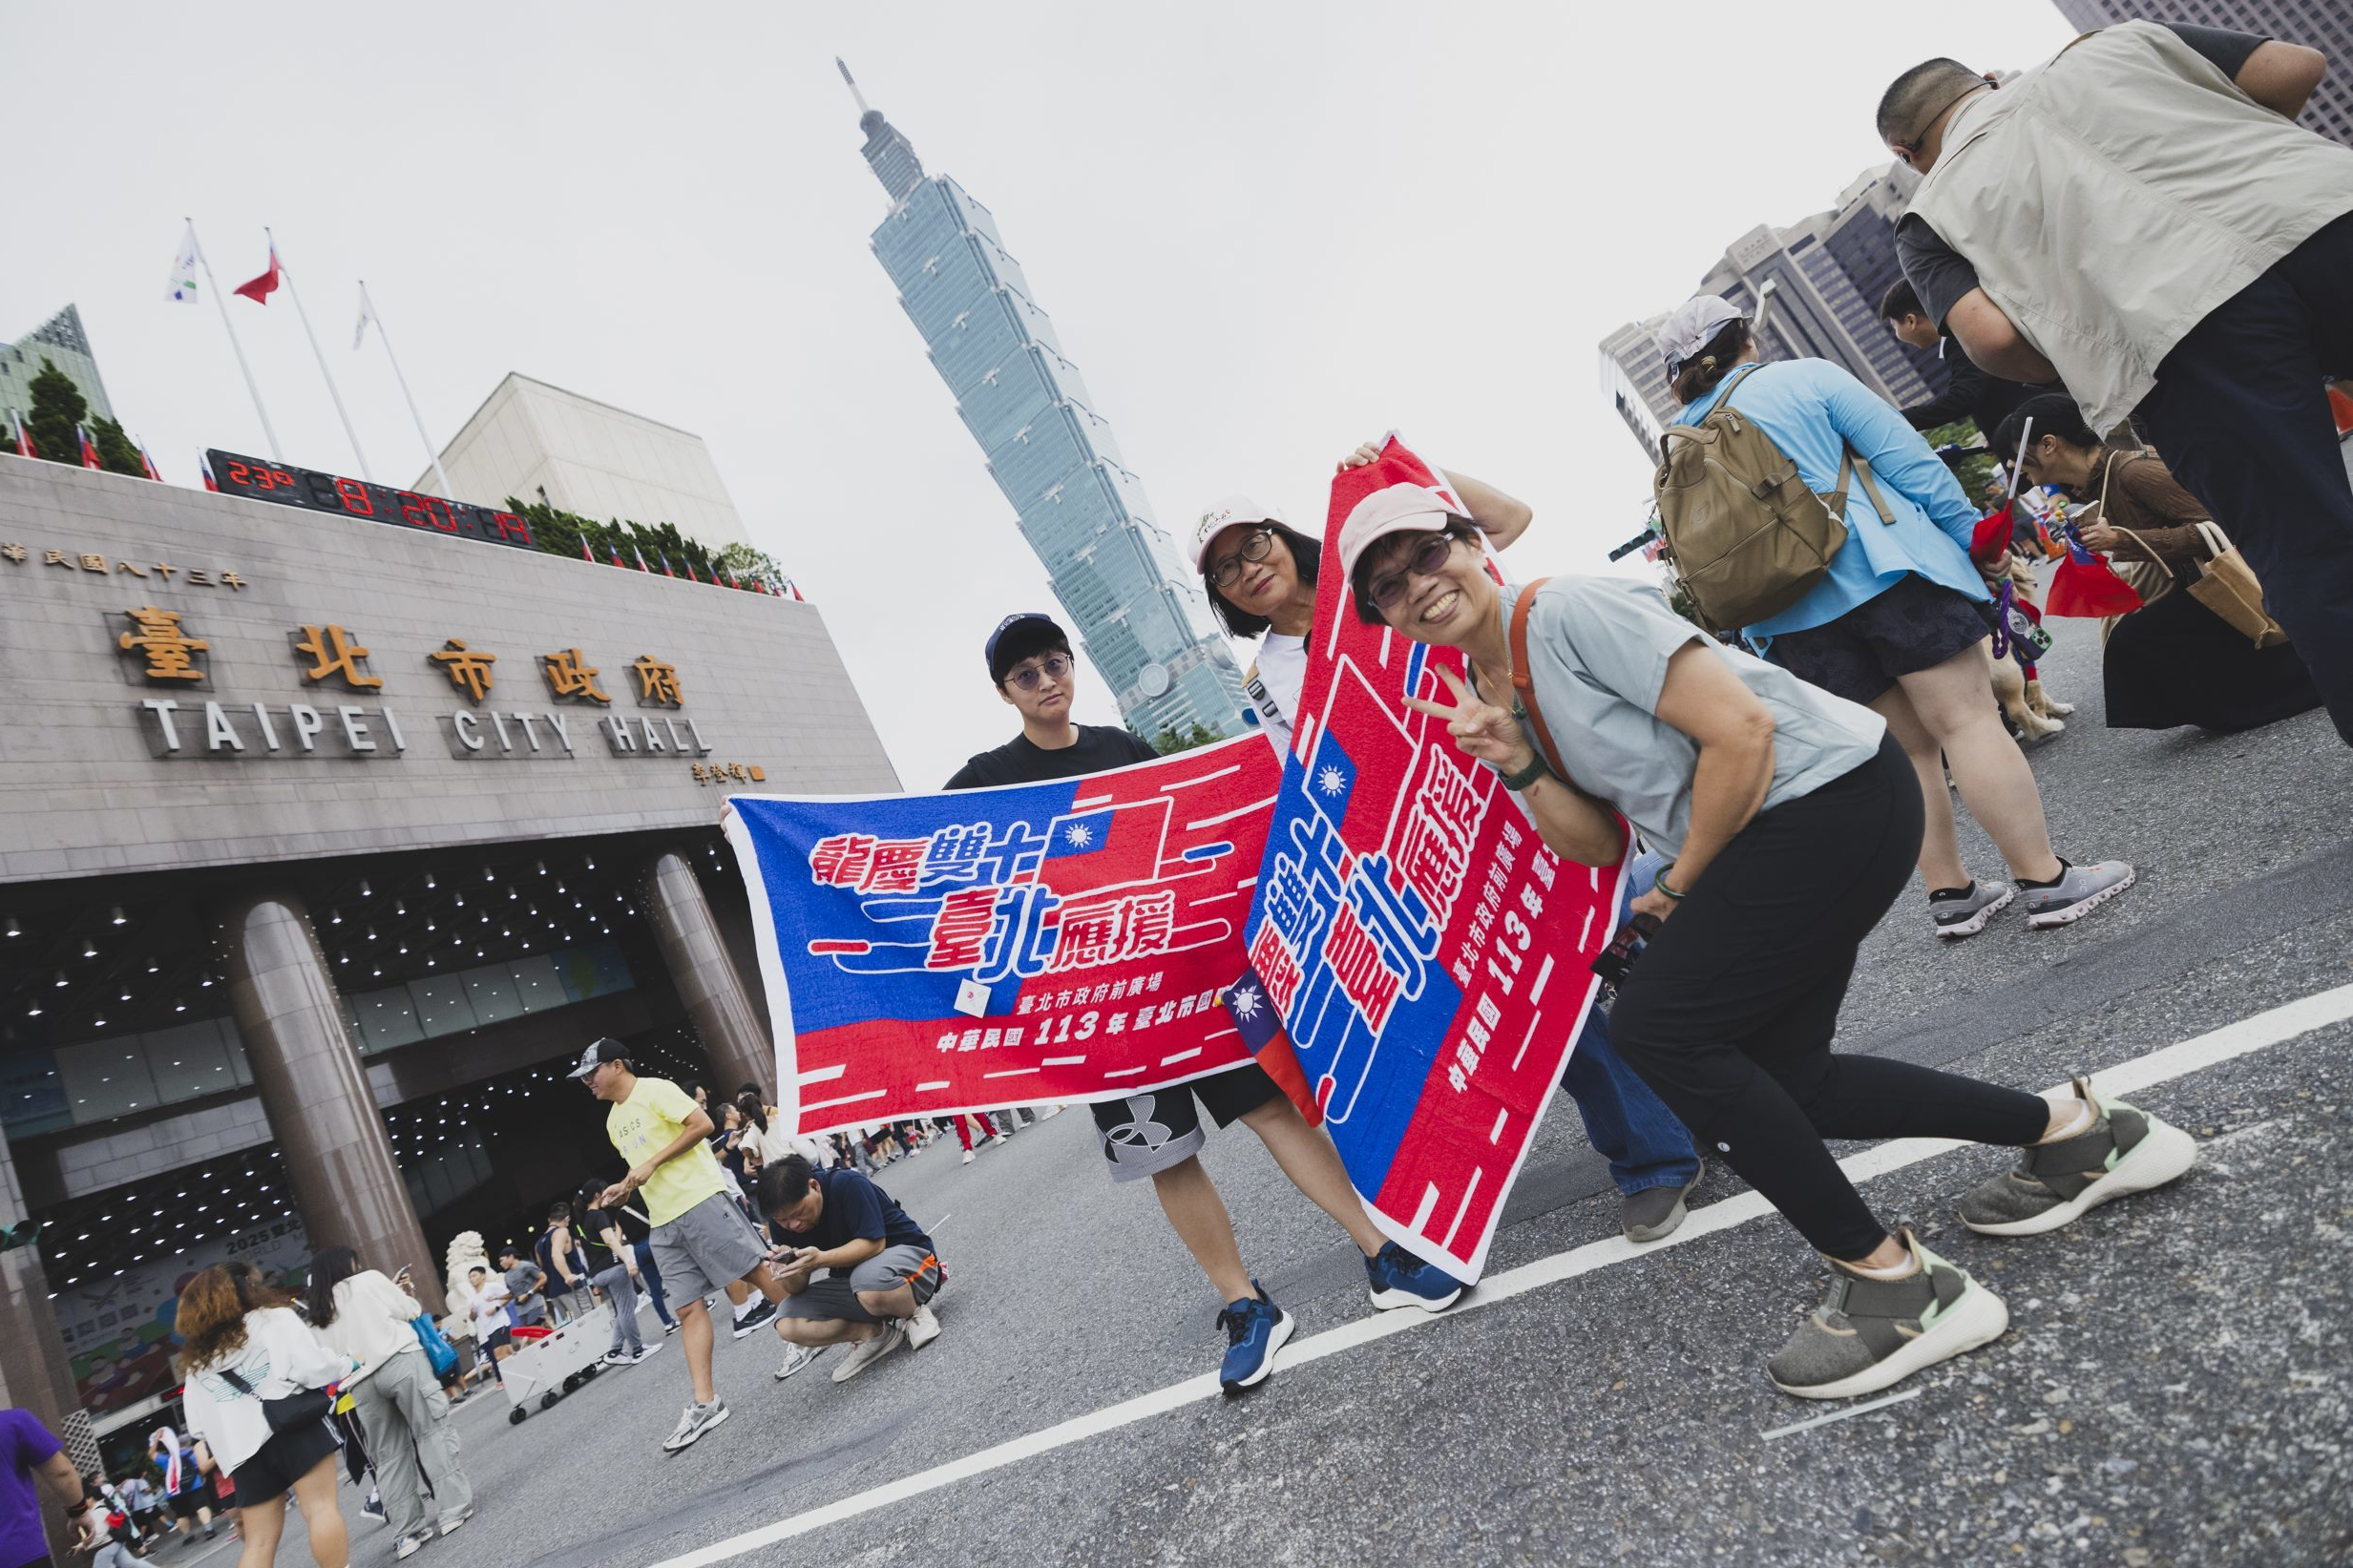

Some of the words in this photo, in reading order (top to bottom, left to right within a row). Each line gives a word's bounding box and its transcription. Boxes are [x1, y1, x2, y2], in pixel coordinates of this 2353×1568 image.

[119, 604, 686, 708] 臺北市政府
[142, 699, 406, 752] TAIPEI
[453, 709, 574, 752] CITY
[607, 716, 712, 753] HALL
[924, 885, 1176, 983] 臺北應援
[1321, 744, 1486, 1037] 臺北應援
[1452, 820, 1523, 989] 臺北市政府前廣場
[936, 1027, 1024, 1054] 中華民國
[1034, 1011, 1100, 1046] 113
[1105, 1012, 1129, 1035] 年
[1017, 971, 1164, 1015] 臺北市政府前廣場
[1447, 991, 1502, 1094] 中華民國
[1486, 909, 1531, 995] 113
[1520, 882, 1544, 920] 年
